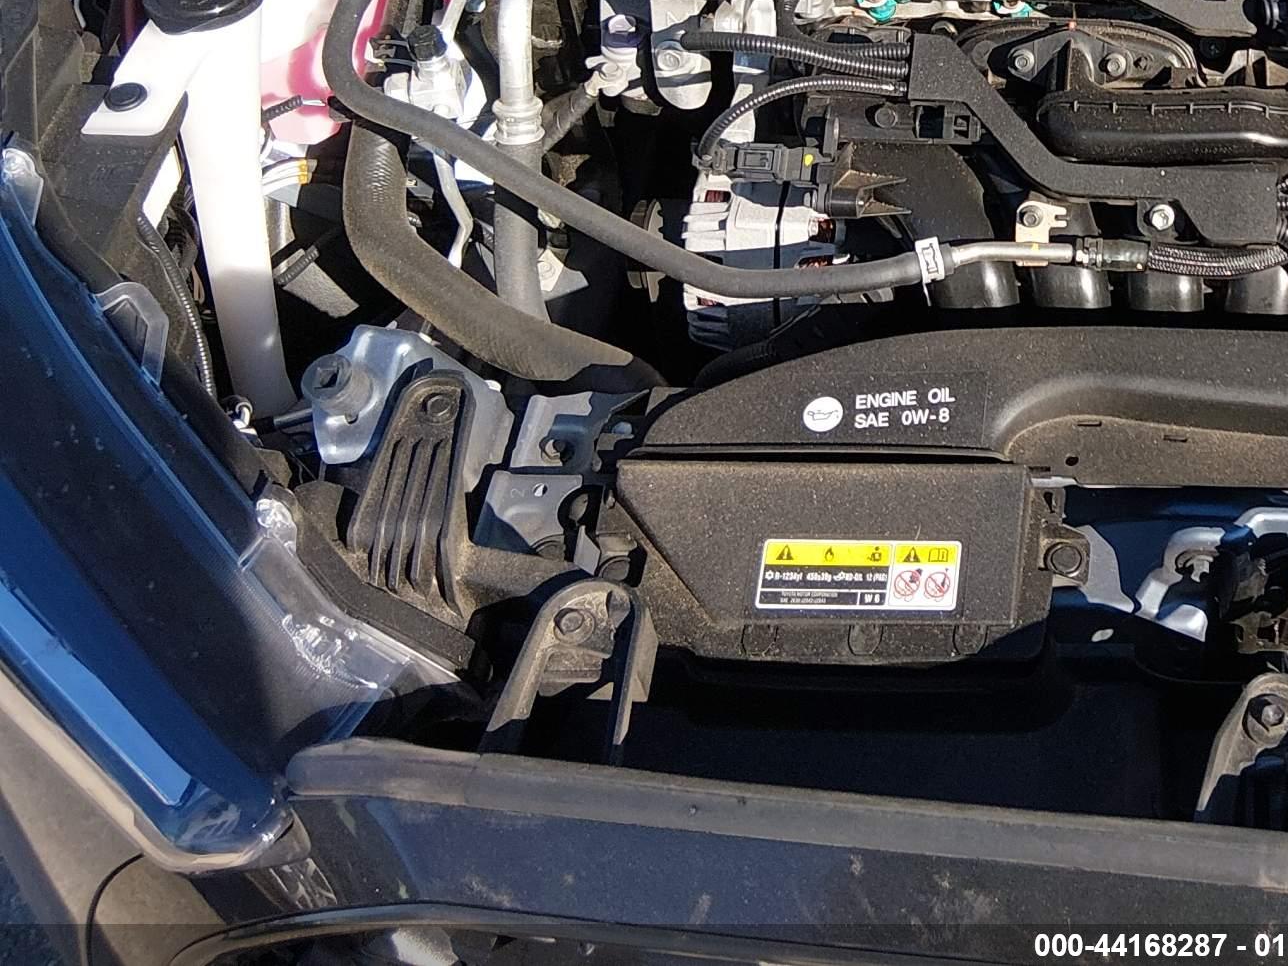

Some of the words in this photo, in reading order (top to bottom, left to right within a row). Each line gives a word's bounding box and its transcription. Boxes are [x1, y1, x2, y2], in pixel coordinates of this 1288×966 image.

[855, 390, 917, 409] ENGINE
[927, 387, 956, 404] OIL
[854, 412, 889, 429] SAE
[901, 407, 950, 426] 0W-8
